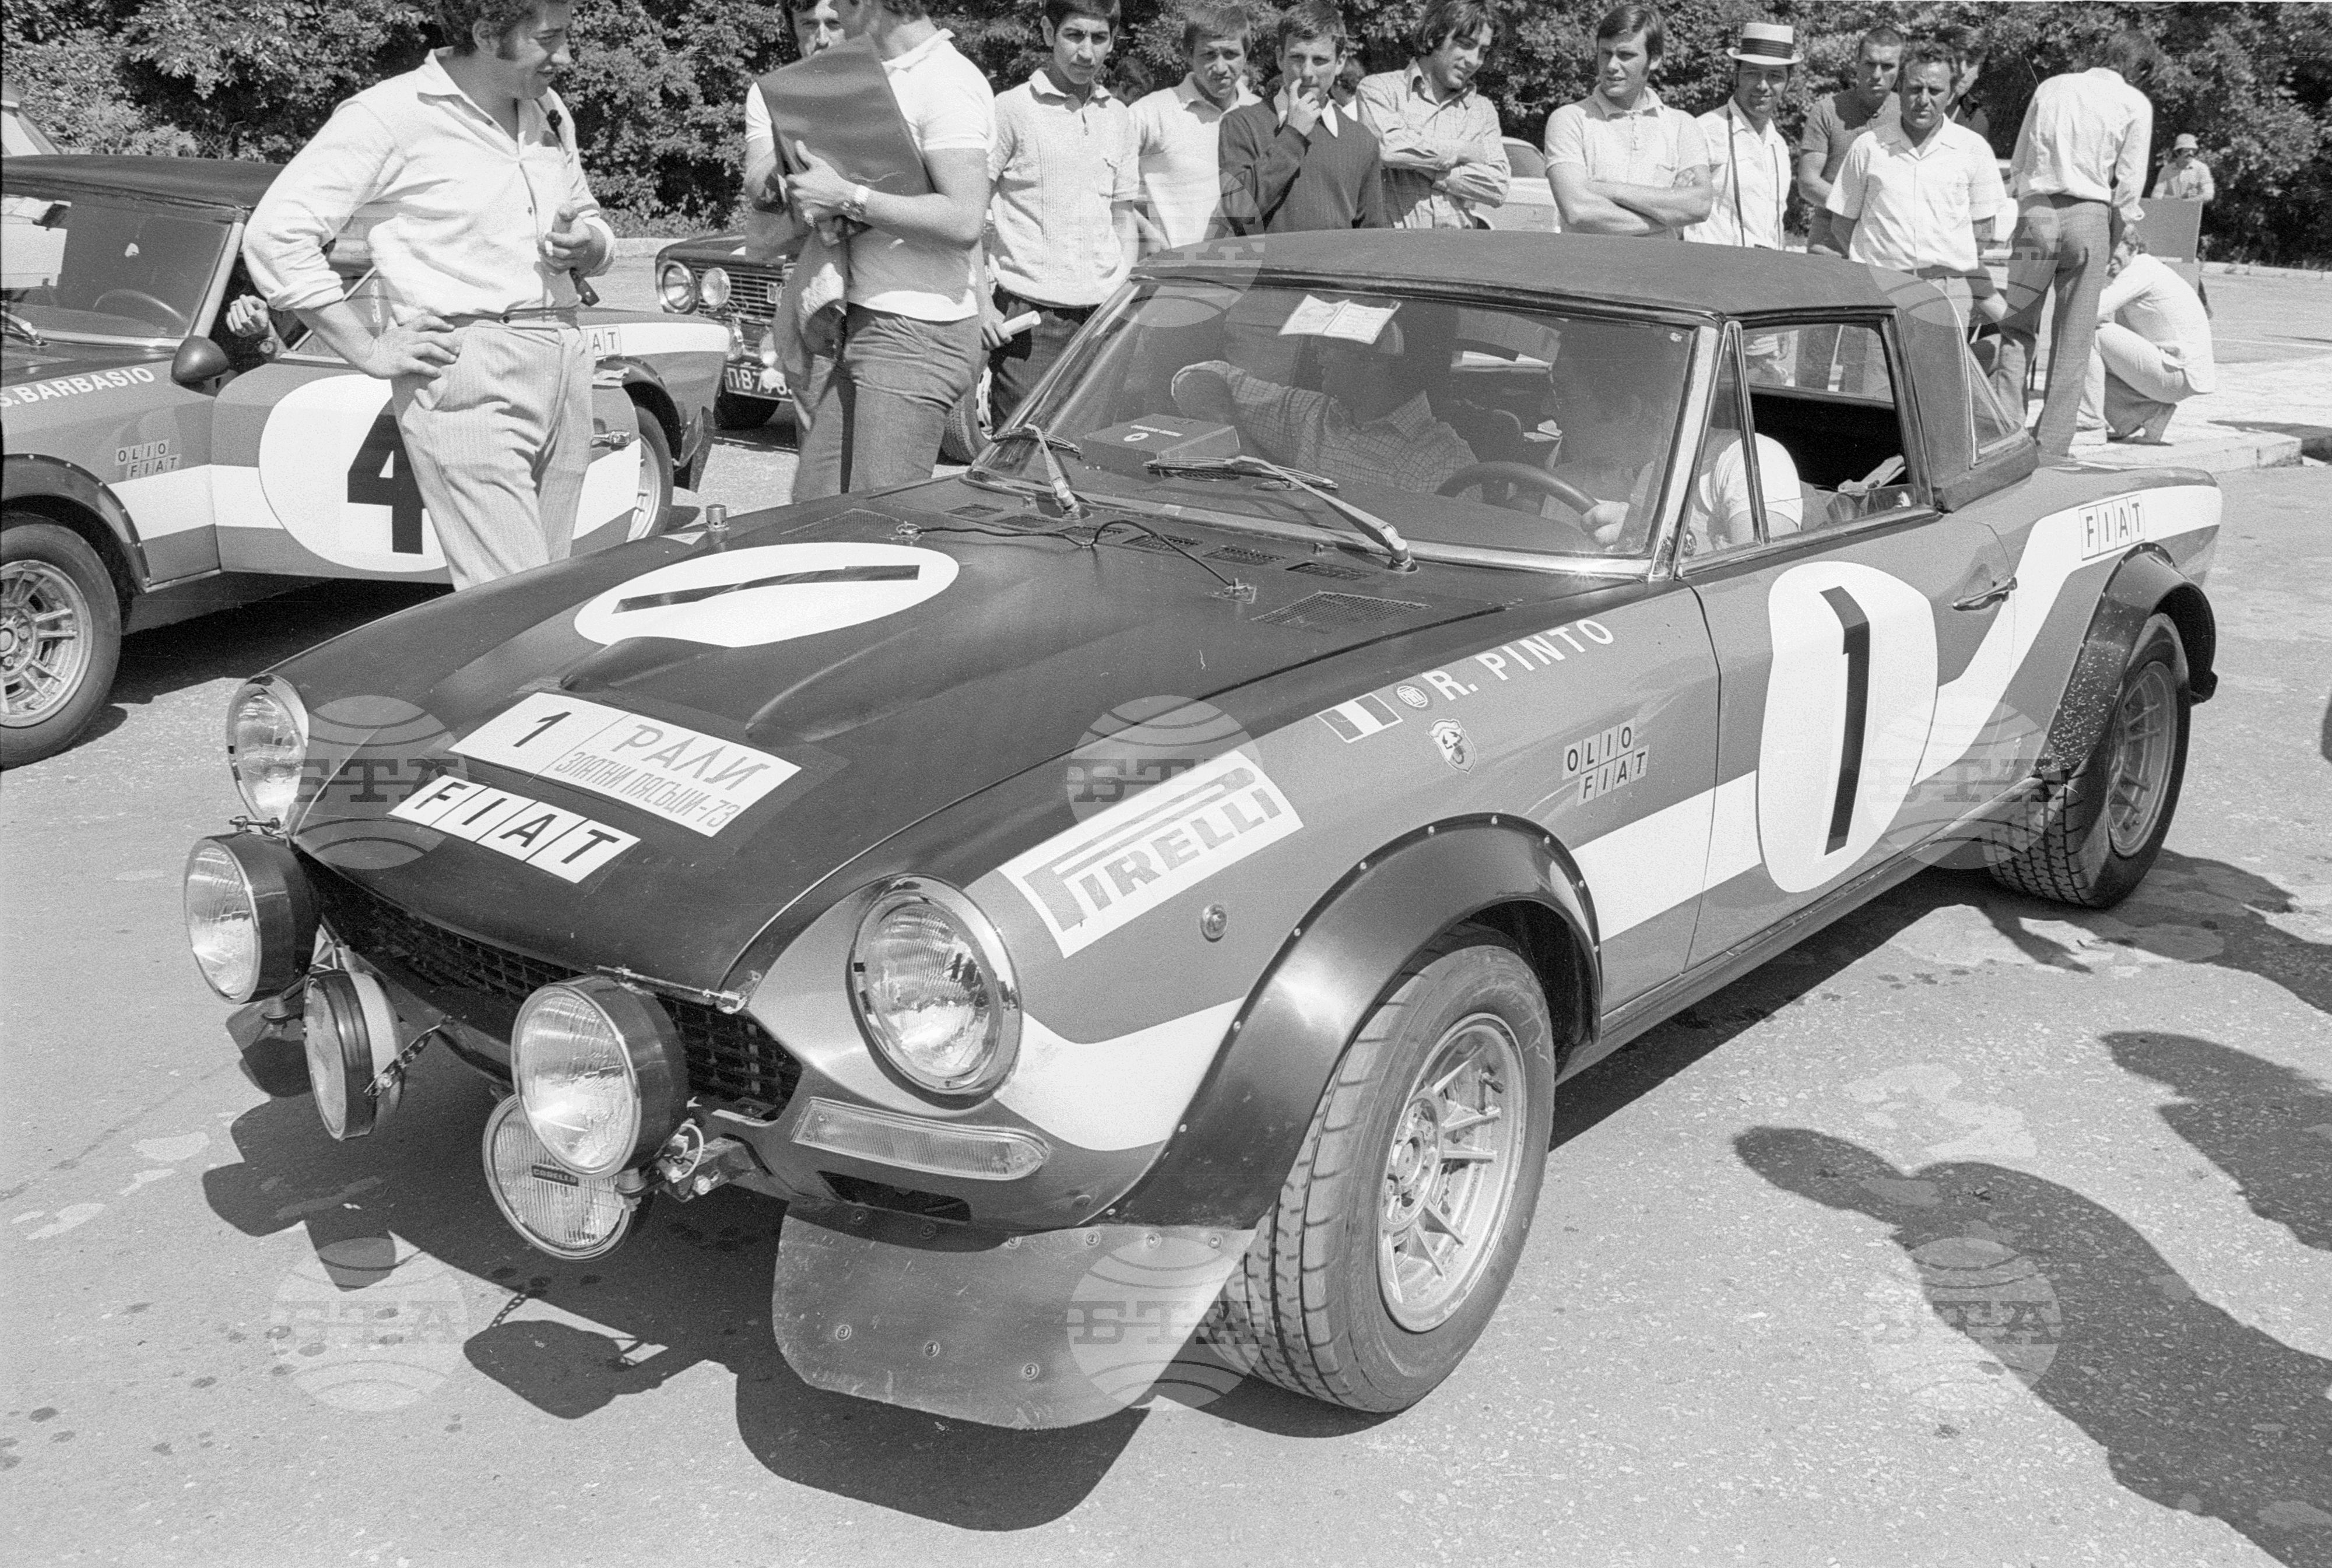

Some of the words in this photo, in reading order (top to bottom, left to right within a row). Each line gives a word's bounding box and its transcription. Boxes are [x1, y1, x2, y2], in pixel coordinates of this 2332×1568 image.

[592, 331, 616, 351] AT
[118, 443, 166, 462] OLIO
[131, 458, 177, 477] FIAT
[347, 396, 427, 555] 4
[2085, 502, 2140, 548] FIAT
[611, 564, 921, 615] 1
[1421, 670, 1479, 701] R.
[1474, 619, 1614, 681] PINTO
[512, 711, 573, 748] 1
[1819, 585, 1870, 856] 1
[554, 751, 638, 789] ЗЛАТНИ
[611, 724, 771, 791] РАЛИ
[1567, 726, 1632, 772] OLIO
[1582, 751, 1646, 800] FIAT
[413, 781, 621, 865] FIAT
[1022, 767, 1283, 932] PIRELLI
